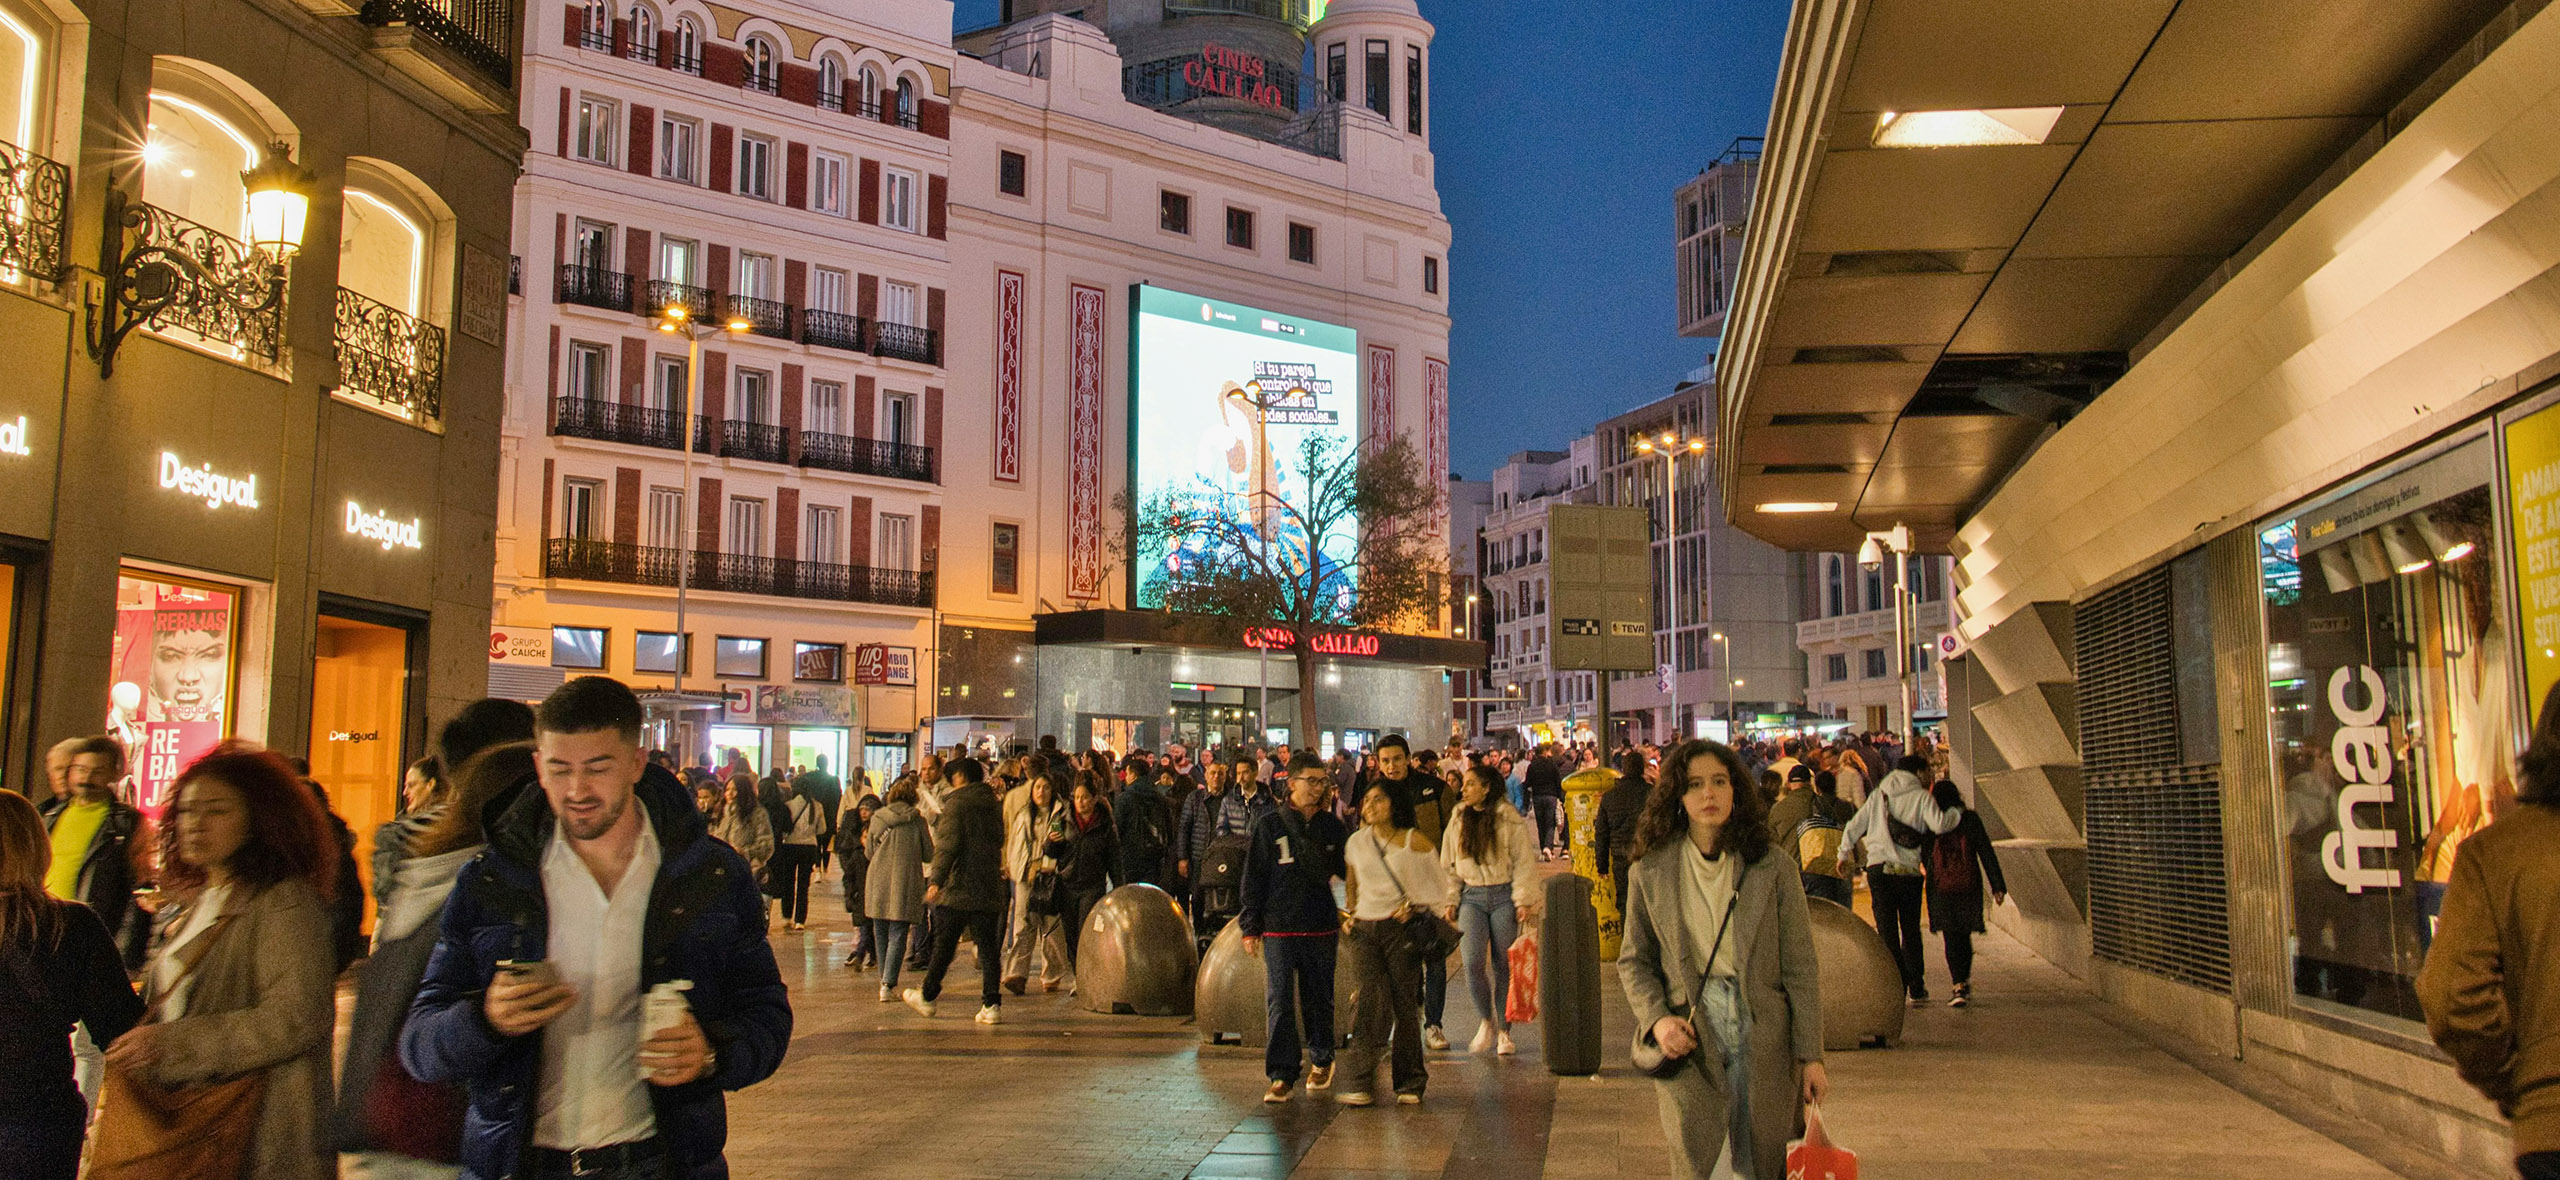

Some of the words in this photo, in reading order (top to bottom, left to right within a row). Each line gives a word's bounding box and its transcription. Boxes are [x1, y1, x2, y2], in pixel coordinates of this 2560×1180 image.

[1203, 41, 1264, 78] CINES
[1183, 60, 1282, 110] CALLAO
[1255, 361, 1265, 375] Si
[1267, 363, 1279, 375] tu
[1280, 364, 1315, 379] pareja
[1313, 381, 1331, 394] que
[1301, 396, 1315, 407] en
[0, 416, 30, 456] al.
[160, 451, 258, 509] Desigual.
[346, 501, 422, 550] Desigual.
[2524, 505, 2544, 539] DE
[162, 591, 211, 605] Desigl.
[156, 611, 226, 632] REBAJAS
[1622, 625, 1644, 633] TEVA
[511, 638, 541, 647] GRUPO
[511, 648, 546, 657] CALICHE
[1312, 632, 1379, 655] CALLAO
[887, 654, 908, 666] MBIO
[887, 667, 909, 679] ANGE
[792, 697, 823, 707] FRUCTIS
[151, 729, 180, 754] RE
[149, 755, 177, 780] BA
[2321, 664, 2402, 894] fnac
[1275, 836, 1295, 864] 1
